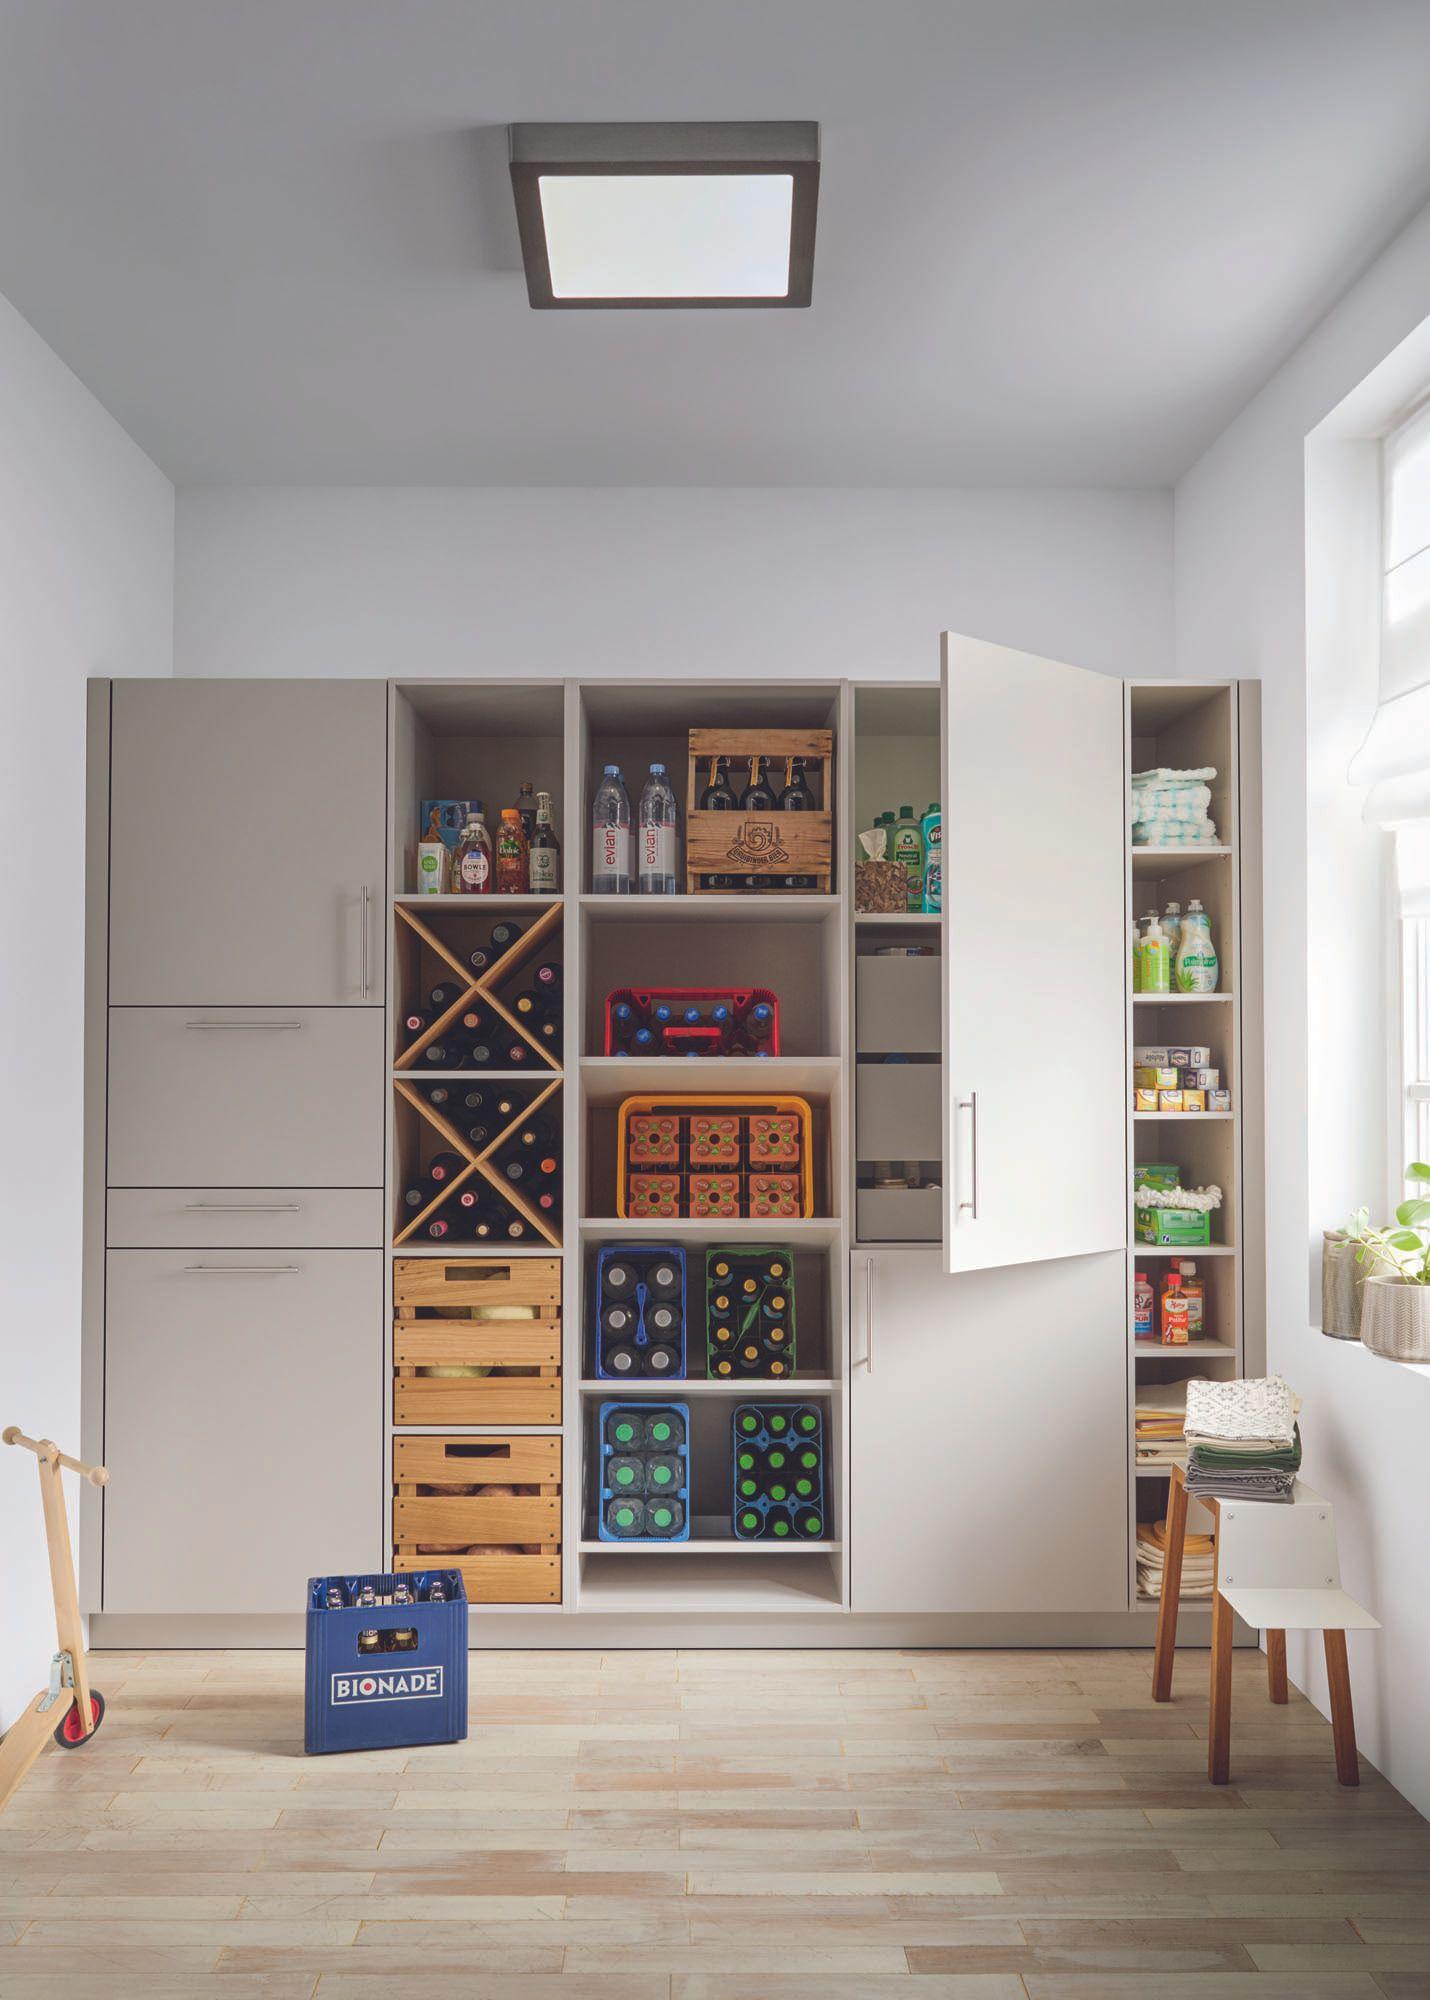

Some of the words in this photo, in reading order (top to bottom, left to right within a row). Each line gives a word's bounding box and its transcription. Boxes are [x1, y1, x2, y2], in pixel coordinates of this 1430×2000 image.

[604, 829, 616, 865] evian
[645, 828, 656, 865] evian
[463, 863, 487, 871] BOWLE
[336, 1673, 438, 1698] BIONADE
